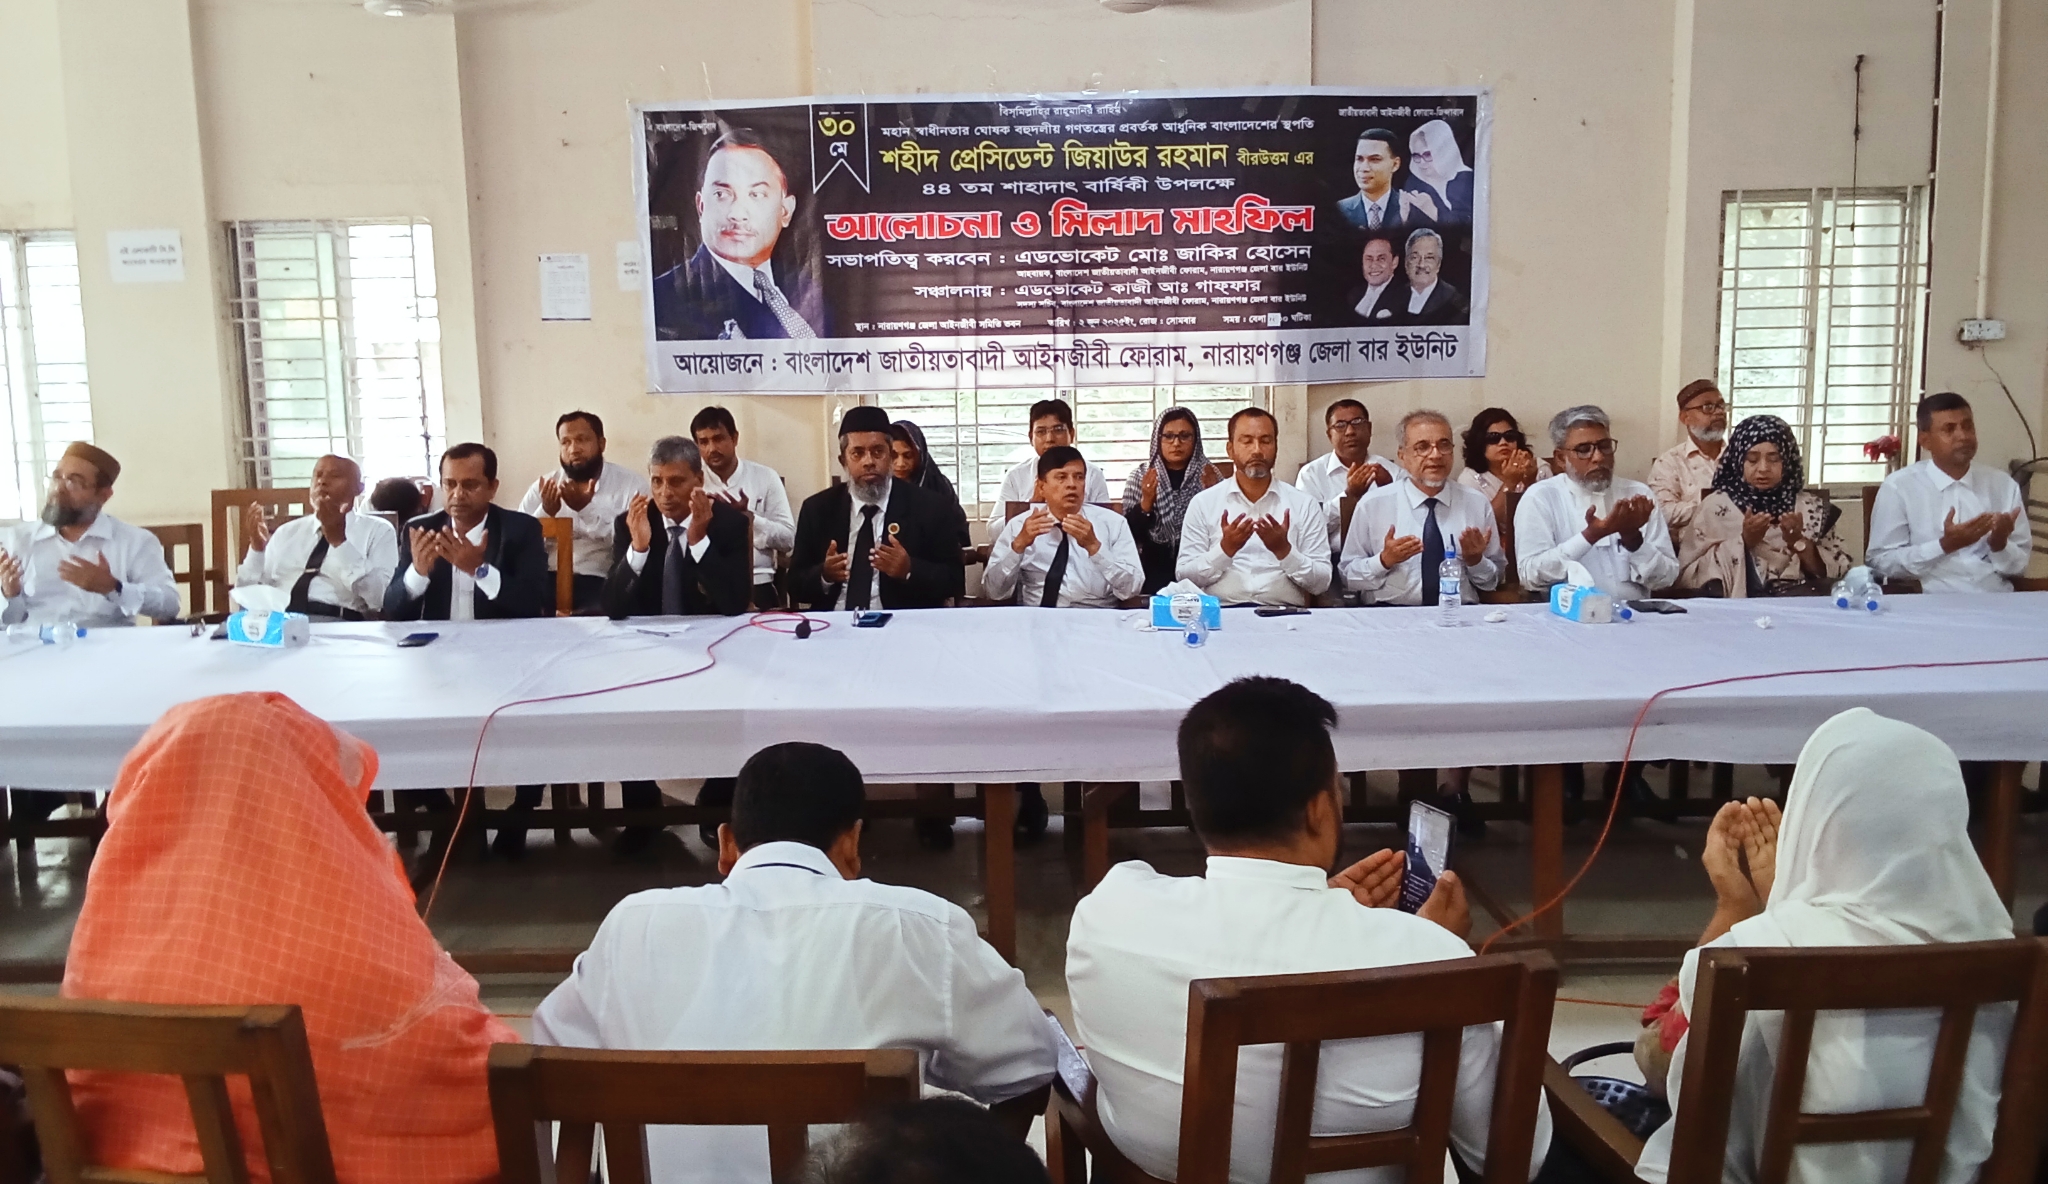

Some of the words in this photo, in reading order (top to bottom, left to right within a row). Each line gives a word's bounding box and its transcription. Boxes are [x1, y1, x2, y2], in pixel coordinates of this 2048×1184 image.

[817, 117, 855, 136] ৩০
[881, 126, 910, 137] মহান
[914, 124, 970, 136] স্বাধীনতার
[974, 125, 1010, 135] ঘোষক
[1014, 122, 1060, 136] বহুদলীয়
[1065, 123, 1115, 134] গণতন্ত্রের
[1119, 120, 1158, 133] প্রবর্তক
[1162, 119, 1207, 134] আধুনিক
[1210, 120, 1278, 131] বাংলাদেশের
[1281, 117, 1315, 132] স্থপতি
[830, 142, 848, 156] মে
[879, 141, 940, 176] শহীদ
[950, 140, 1055, 173] প্রেসিডেন্ট
[1061, 138, 1149, 170] জিয়াউর
[1155, 142, 1229, 171] রহমান
[1236, 147, 1289, 166] বীরউত্তম
[1294, 151, 1314, 165] এর
[922, 183, 951, 195] ৪৪
[959, 182, 994, 194] তম
[1001, 179, 1078, 195] শাহাদাৎ
[1082, 176, 1149, 193] বার্ষিকী
[1154, 175, 1235, 191] উপলক্ষে
[824, 211, 1002, 242] আলোচনা
[1011, 211, 1041, 238] ও
[1048, 197, 1164, 237] মিলাদ
[1170, 193, 1315, 235] মাহফিল
[825, 249, 919, 270] সভাপতিত্ব
[924, 252, 992, 267] করবেন
[1015, 245, 1121, 264] এডভোকেট
[1128, 247, 1169, 262] মোঃ
[1174, 243, 1239, 261] জাকির
[1246, 245, 1312, 261] হোসেন
[912, 284, 993, 299] সঞ্চালনায়
[1015, 280, 1104, 296] এডভোকেট
[1109, 278, 1152, 295] কাজী
[1157, 280, 1188, 294] আঃ
[673, 352, 764, 375] আয়োজনে
[784, 349, 872, 375] বাংলাদেশ
[877, 341, 1006, 372] জাতীয়তাবাদী
[1012, 338, 1111, 372] আইনজীবী
[1120, 343, 1194, 372] ফোরাম,
[1200, 340, 1301, 367] নারায়ণগঞ্জ
[1309, 338, 1351, 363] জেলা
[1357, 338, 1389, 362] বার
[1395, 331, 1458, 364] ইউনিট
